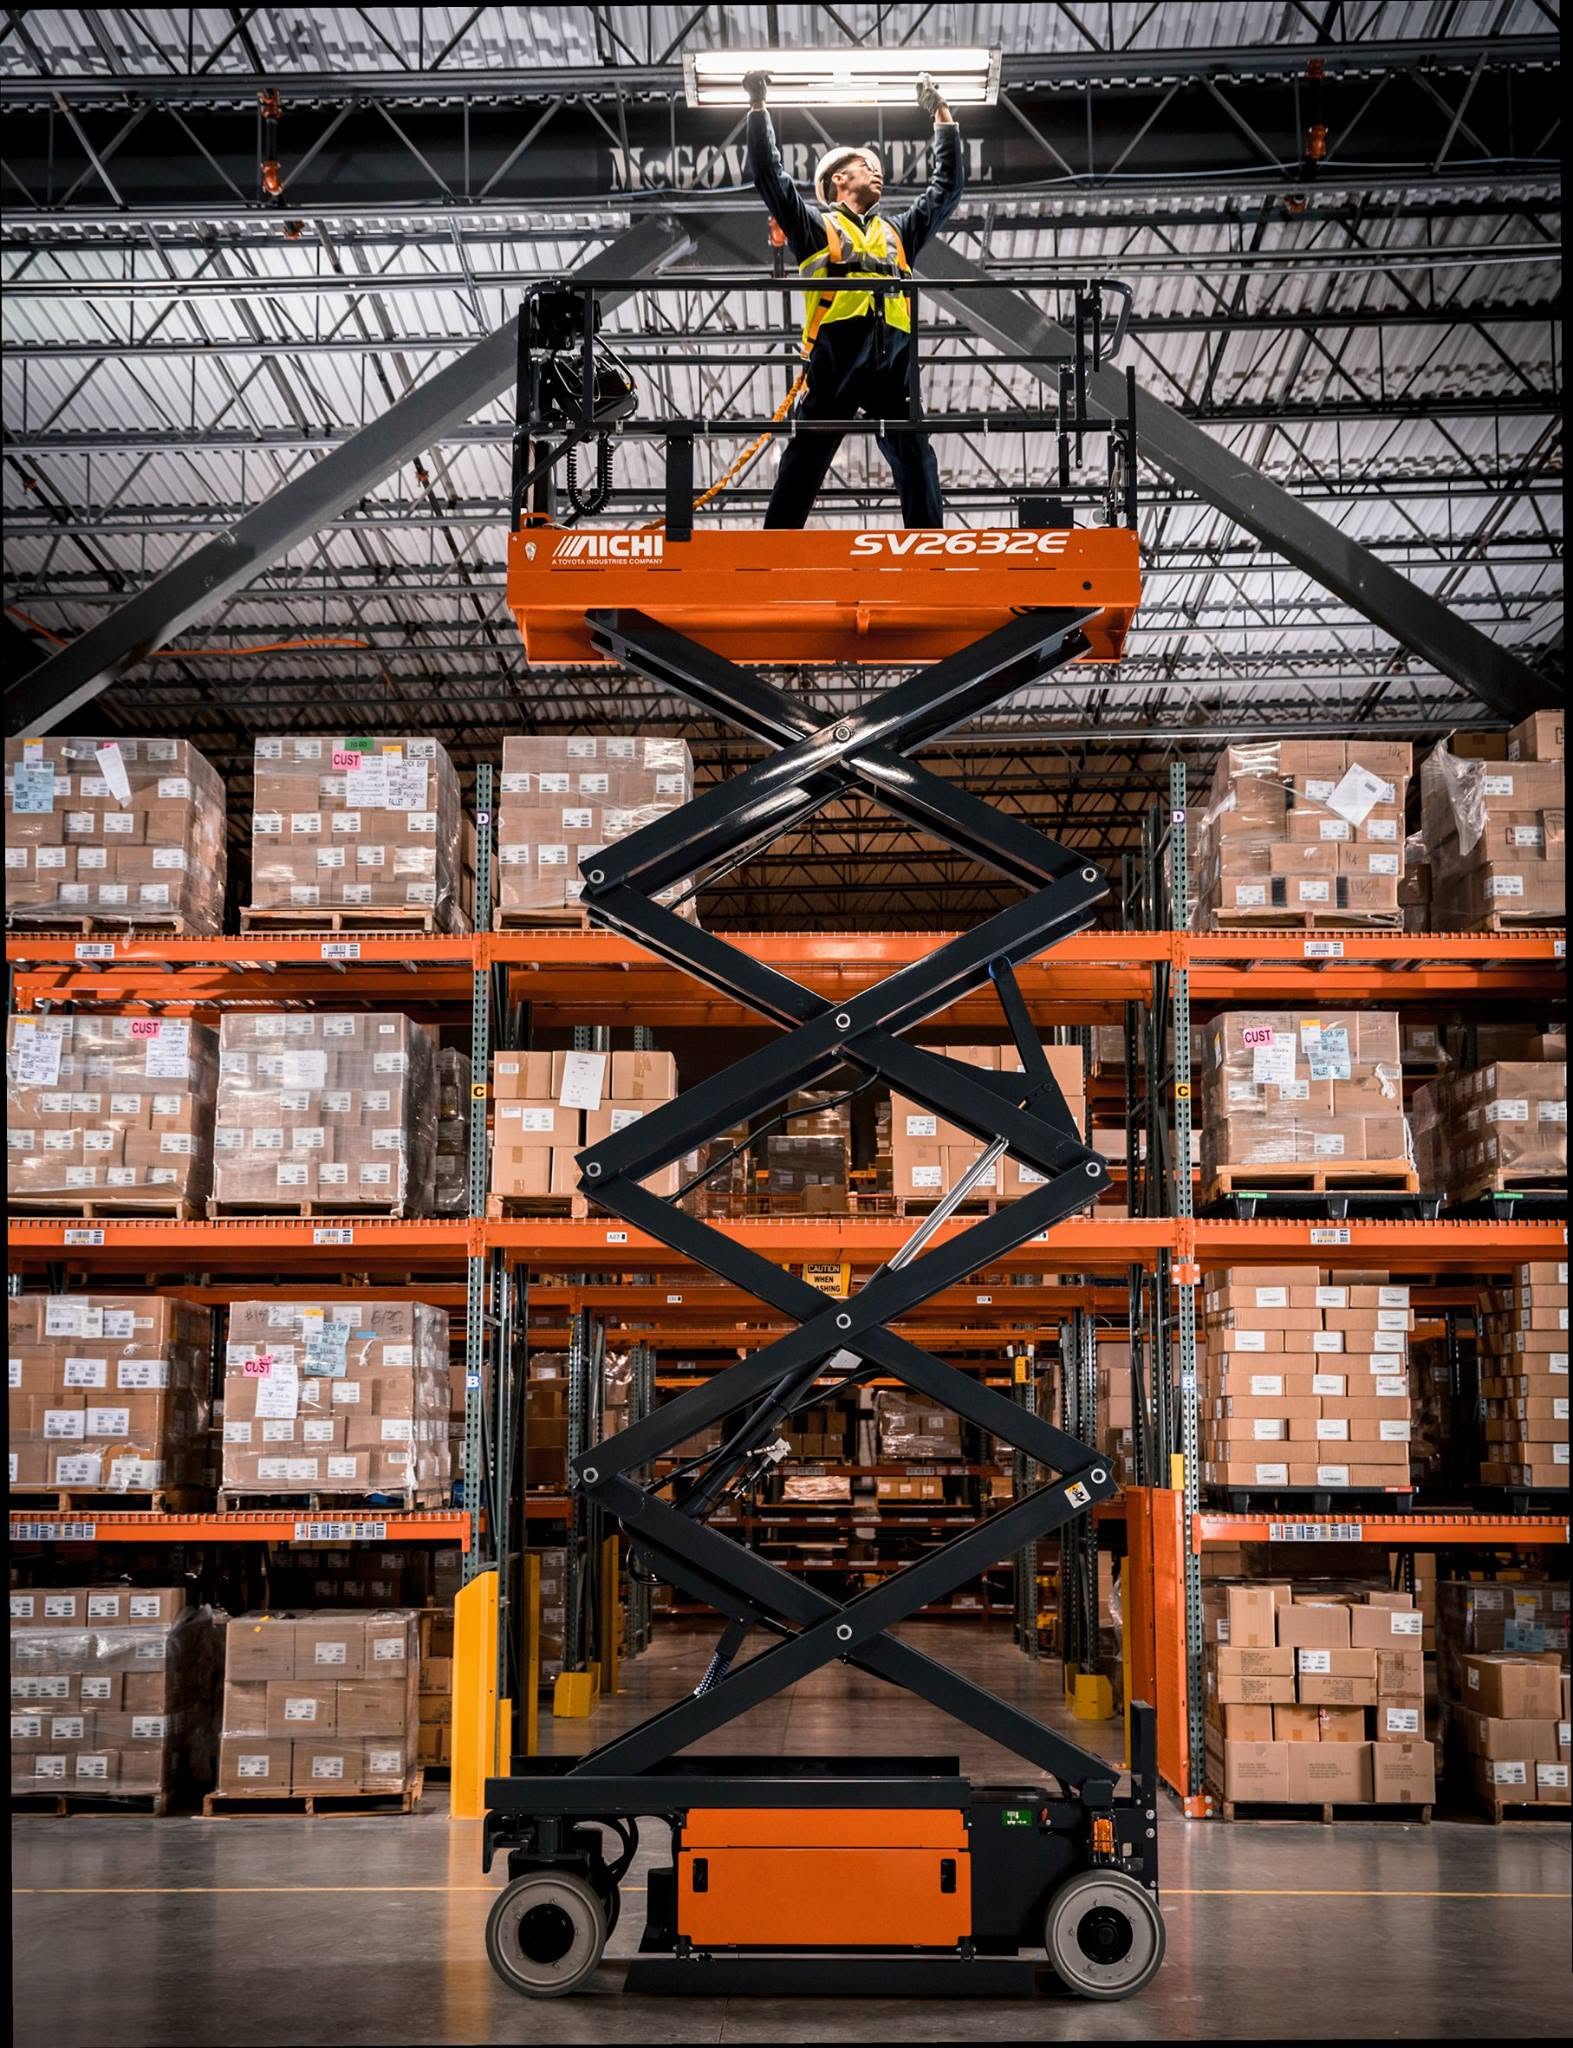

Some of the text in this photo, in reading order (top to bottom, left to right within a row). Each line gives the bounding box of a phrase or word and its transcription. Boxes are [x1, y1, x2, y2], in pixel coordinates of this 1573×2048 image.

[863, 138, 992, 184] TEL
[552, 535, 663, 557] AICHI
[850, 531, 1071, 556] SV2632E
[333, 754, 360, 767] CUST
[477, 812, 489, 825] D
[1172, 811, 1185, 823] D
[132, 1022, 159, 1034] CUST
[1244, 1029, 1271, 1044] CUST
[473, 1086, 484, 1098] C
[1177, 1085, 1189, 1097] C
[808, 1264, 840, 1272] CAUTION
[245, 1361, 270, 1373] CUST
[467, 1375, 480, 1388] B
